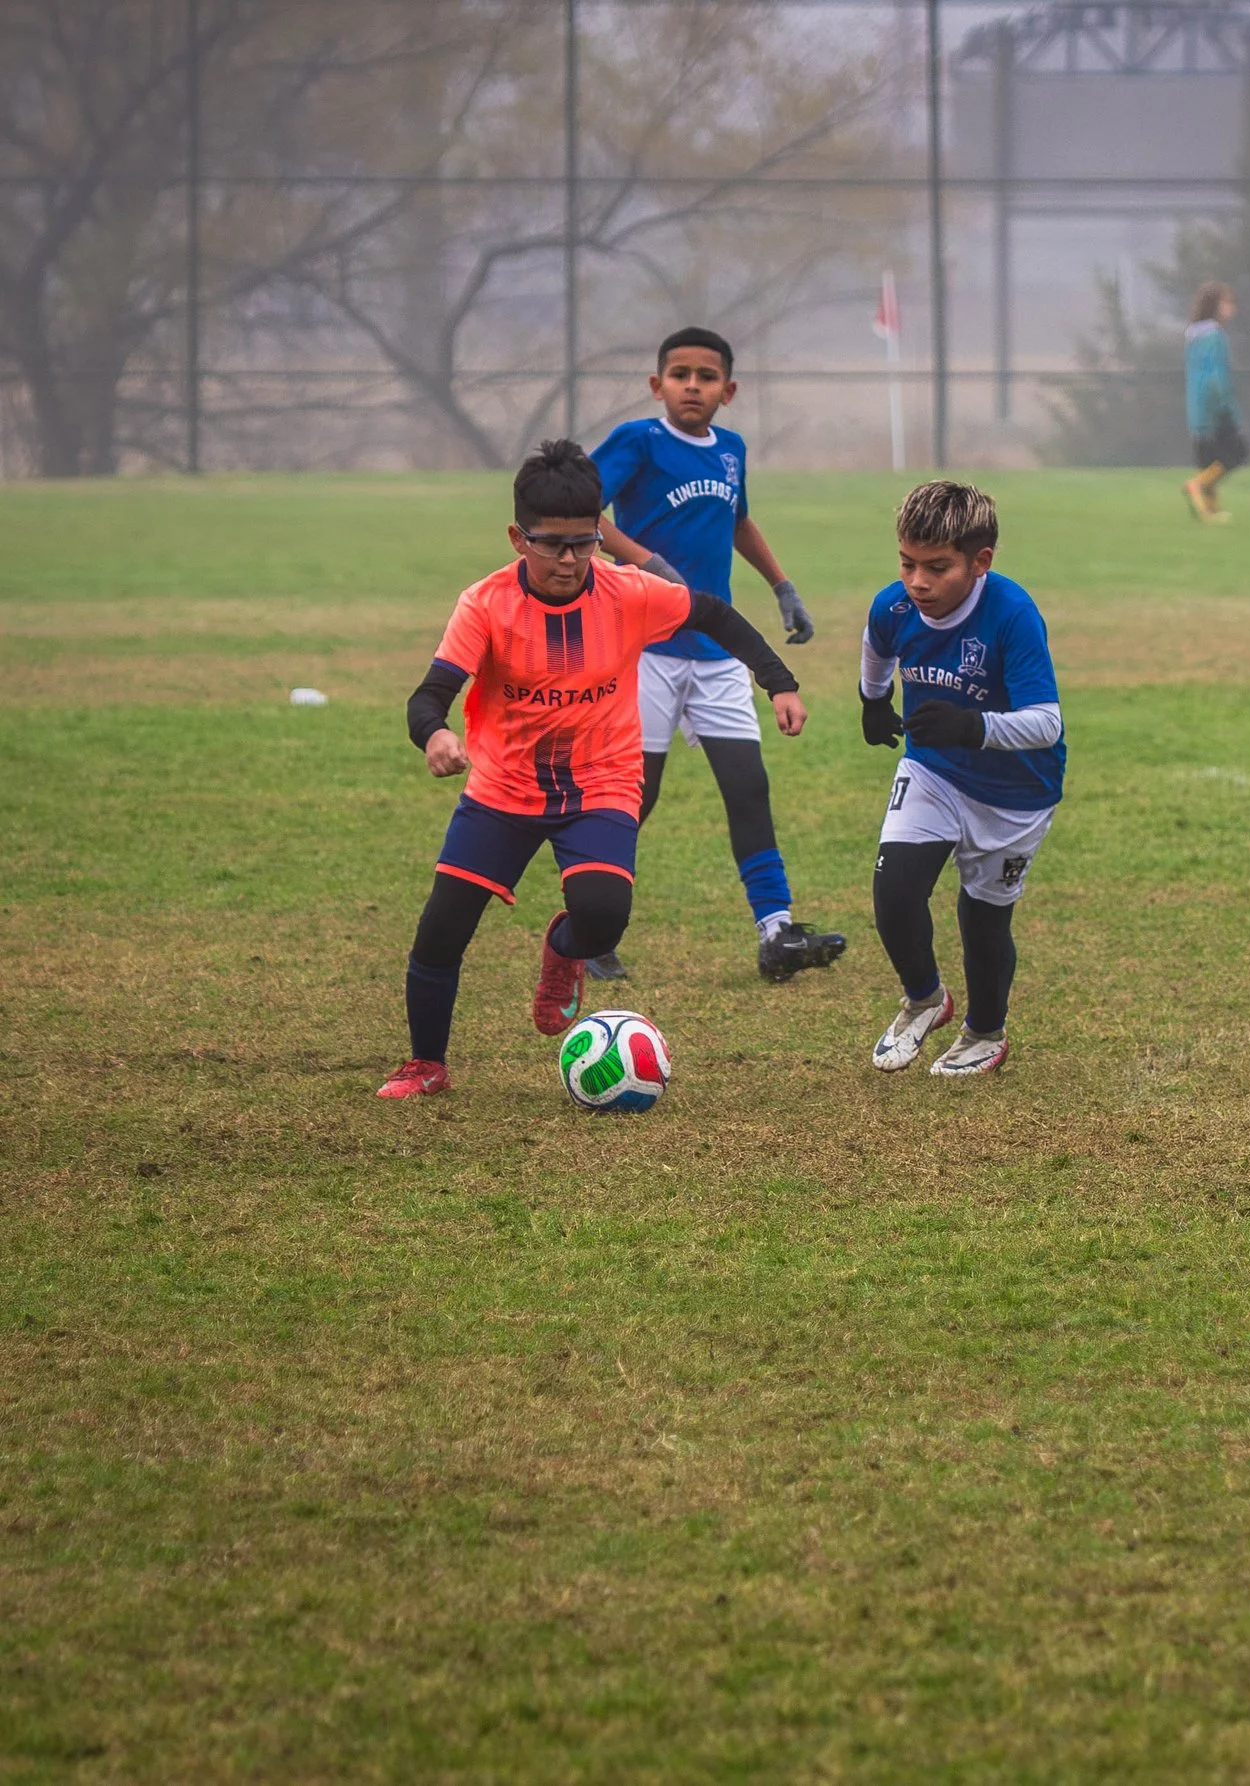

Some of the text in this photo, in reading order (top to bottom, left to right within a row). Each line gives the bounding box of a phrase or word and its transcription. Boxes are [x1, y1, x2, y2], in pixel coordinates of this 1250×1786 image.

[666, 479, 732, 508] KINELEROS
[503, 677, 617, 707] SPARTANS
[966, 683, 989, 701] FC
